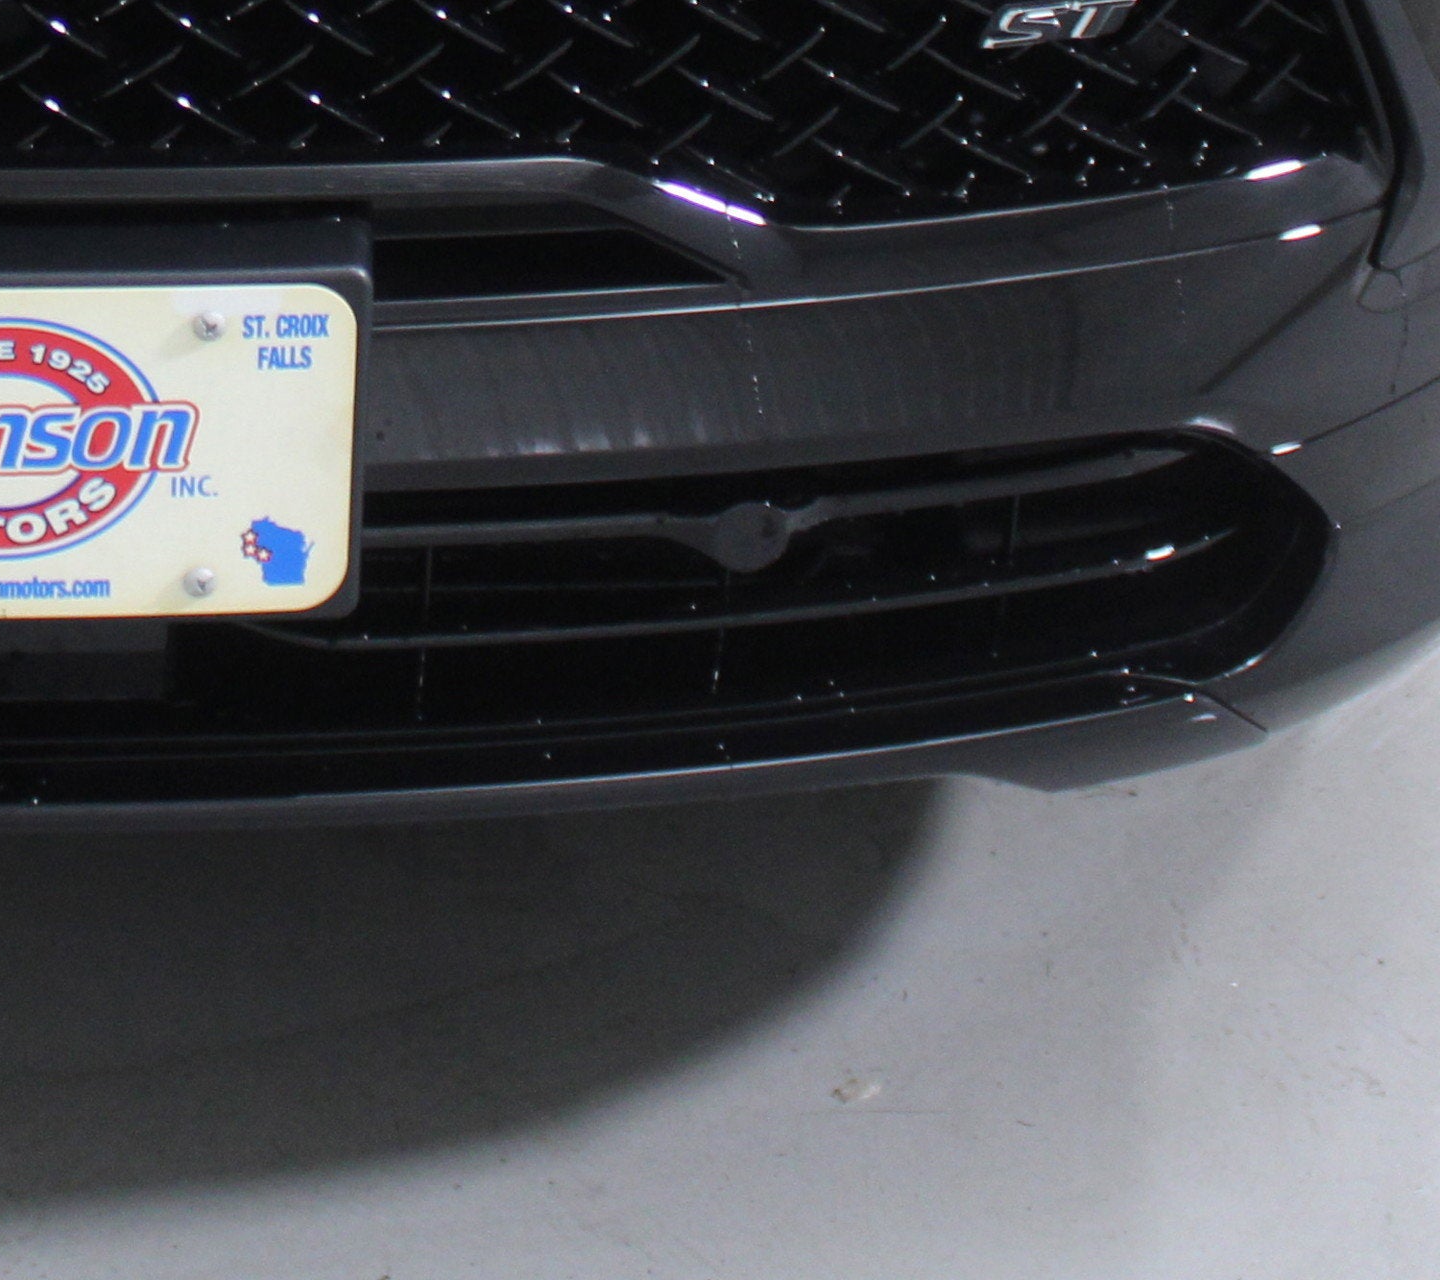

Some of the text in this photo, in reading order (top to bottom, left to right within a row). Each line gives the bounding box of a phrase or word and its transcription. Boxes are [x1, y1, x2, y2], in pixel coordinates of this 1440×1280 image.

[242, 314, 329, 338] ST. CROIX
[257, 346, 312, 369] FALLS
[29, 343, 111, 396] 1925
[171, 476, 218, 497] INC.
